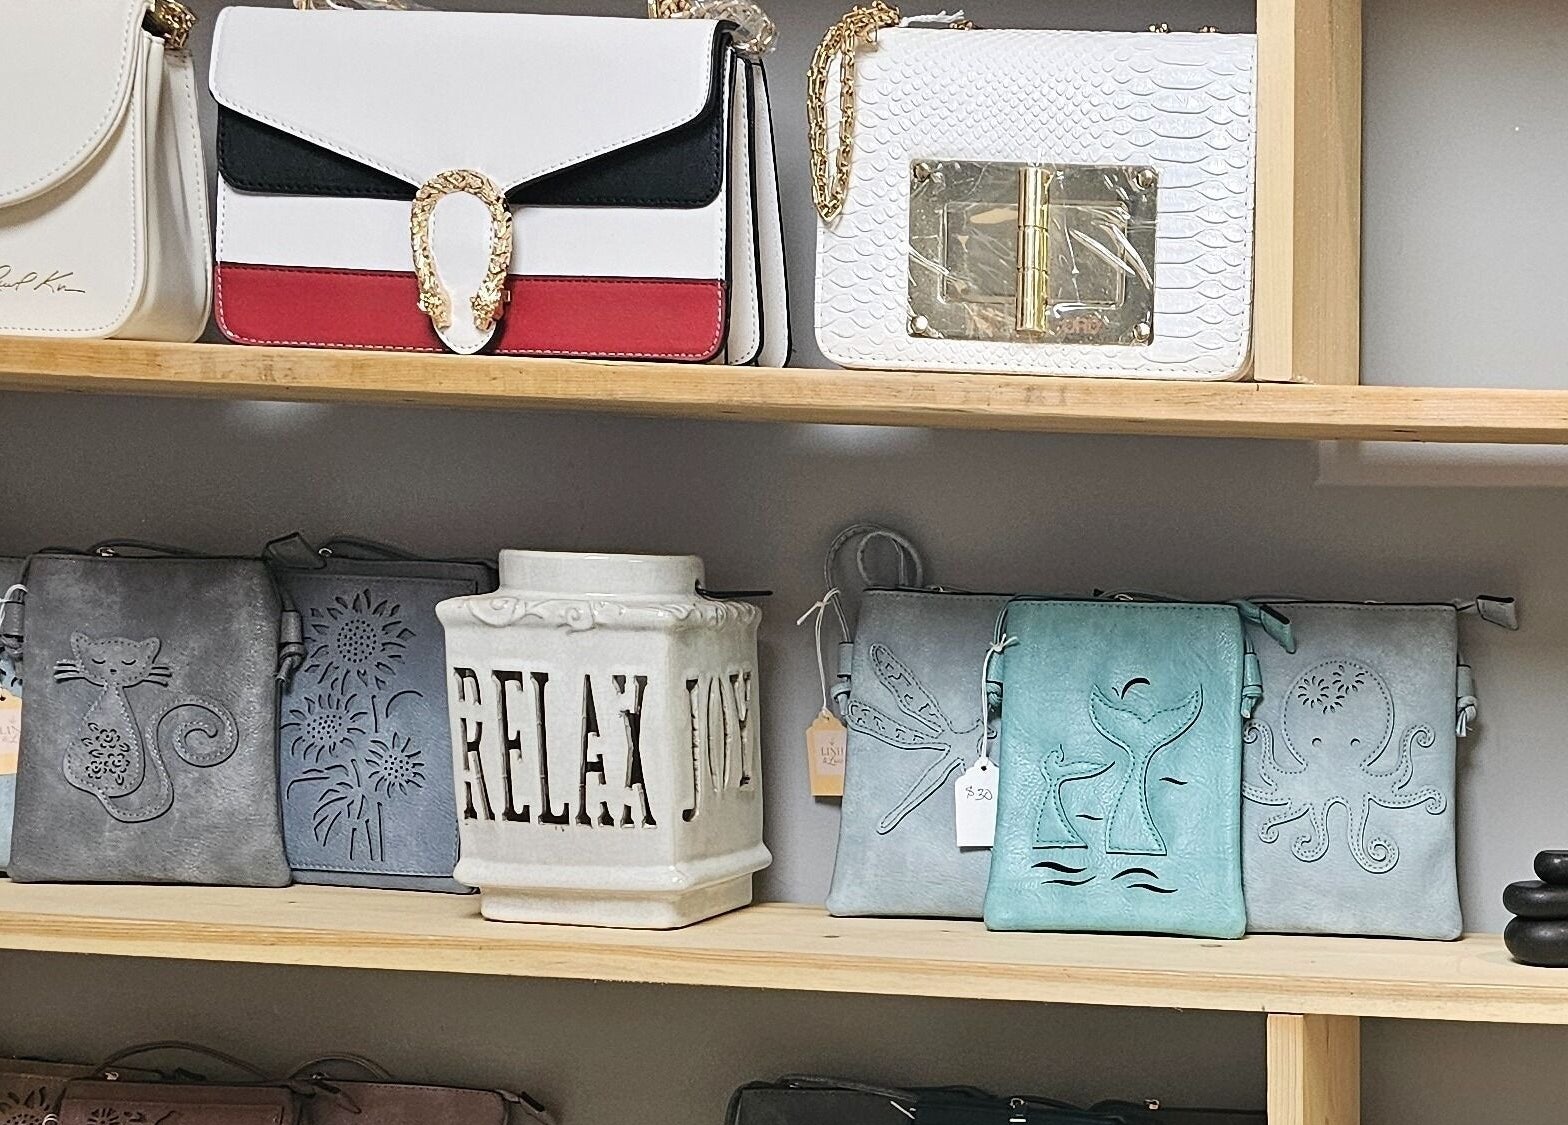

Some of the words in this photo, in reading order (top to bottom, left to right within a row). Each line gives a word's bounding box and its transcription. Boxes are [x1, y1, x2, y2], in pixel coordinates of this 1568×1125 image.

[453, 667, 657, 829] RELAX
[682, 671, 752, 822] JOY
[965, 786, 993, 801] $30
